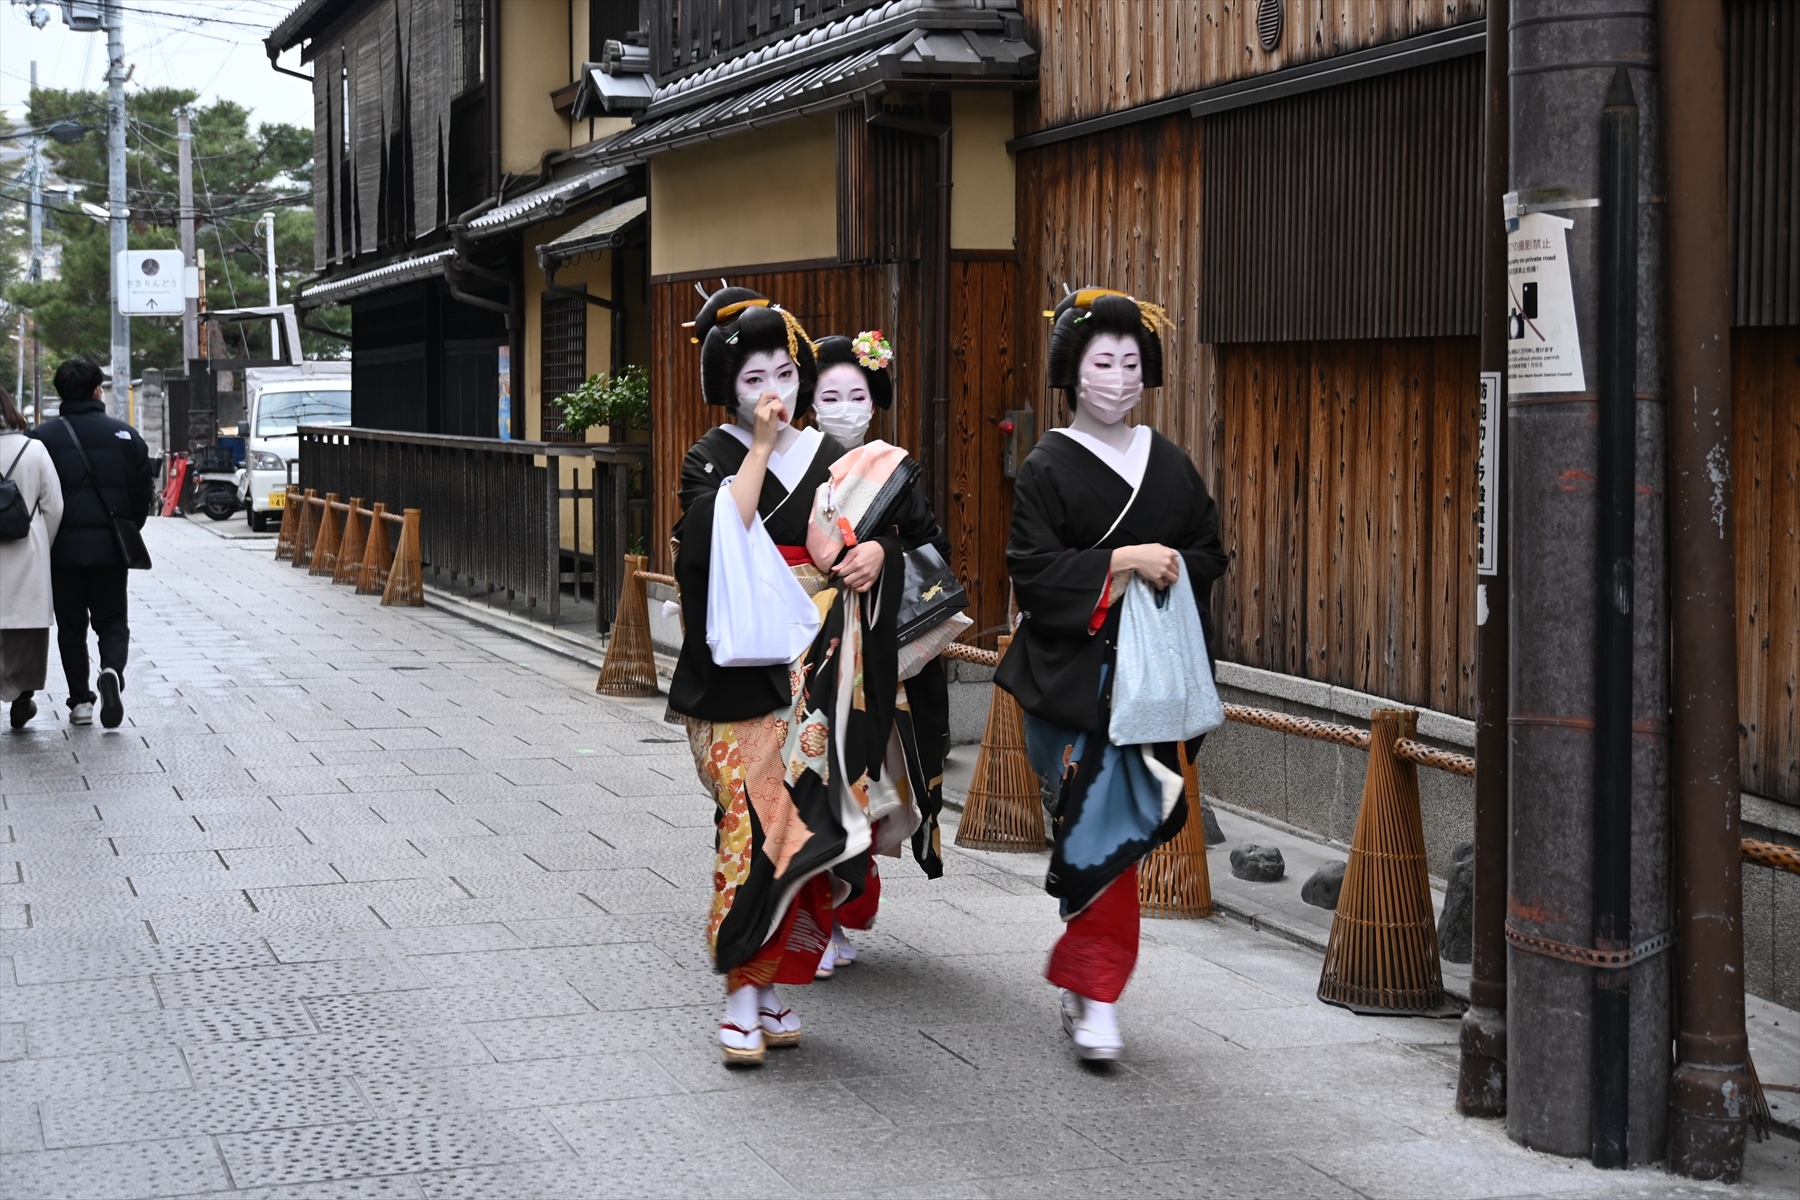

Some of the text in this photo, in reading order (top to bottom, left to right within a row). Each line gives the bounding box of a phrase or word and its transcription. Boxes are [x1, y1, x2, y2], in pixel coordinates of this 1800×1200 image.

[1525, 256, 1542, 264] private
[127, 279, 177, 288] ささりんどう
[1543, 354, 1560, 362] permit
